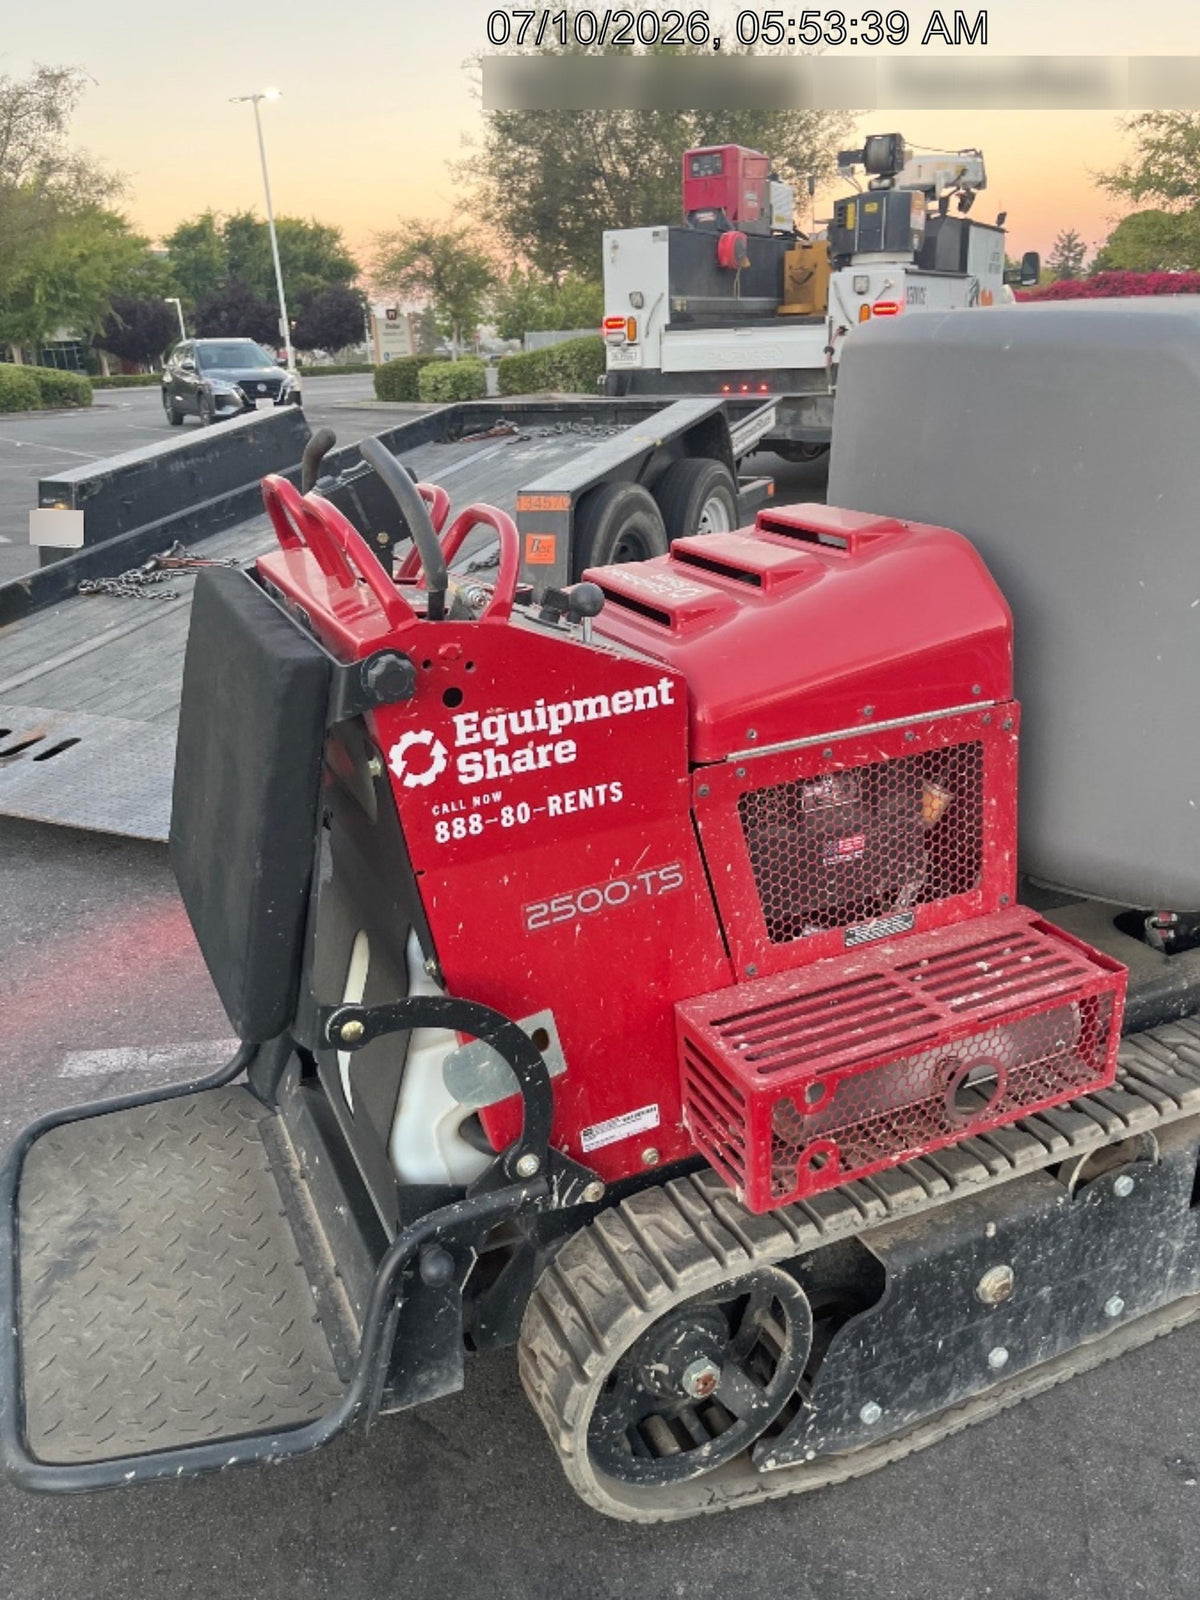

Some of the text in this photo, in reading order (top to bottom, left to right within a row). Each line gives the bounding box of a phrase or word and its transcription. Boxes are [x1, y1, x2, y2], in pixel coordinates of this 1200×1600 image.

[453, 677, 675, 747] Equipment
[456, 738, 578, 785] Share
[431, 790, 502, 816] CALL NOW
[434, 781, 624, 844] 888-80-RENTS
